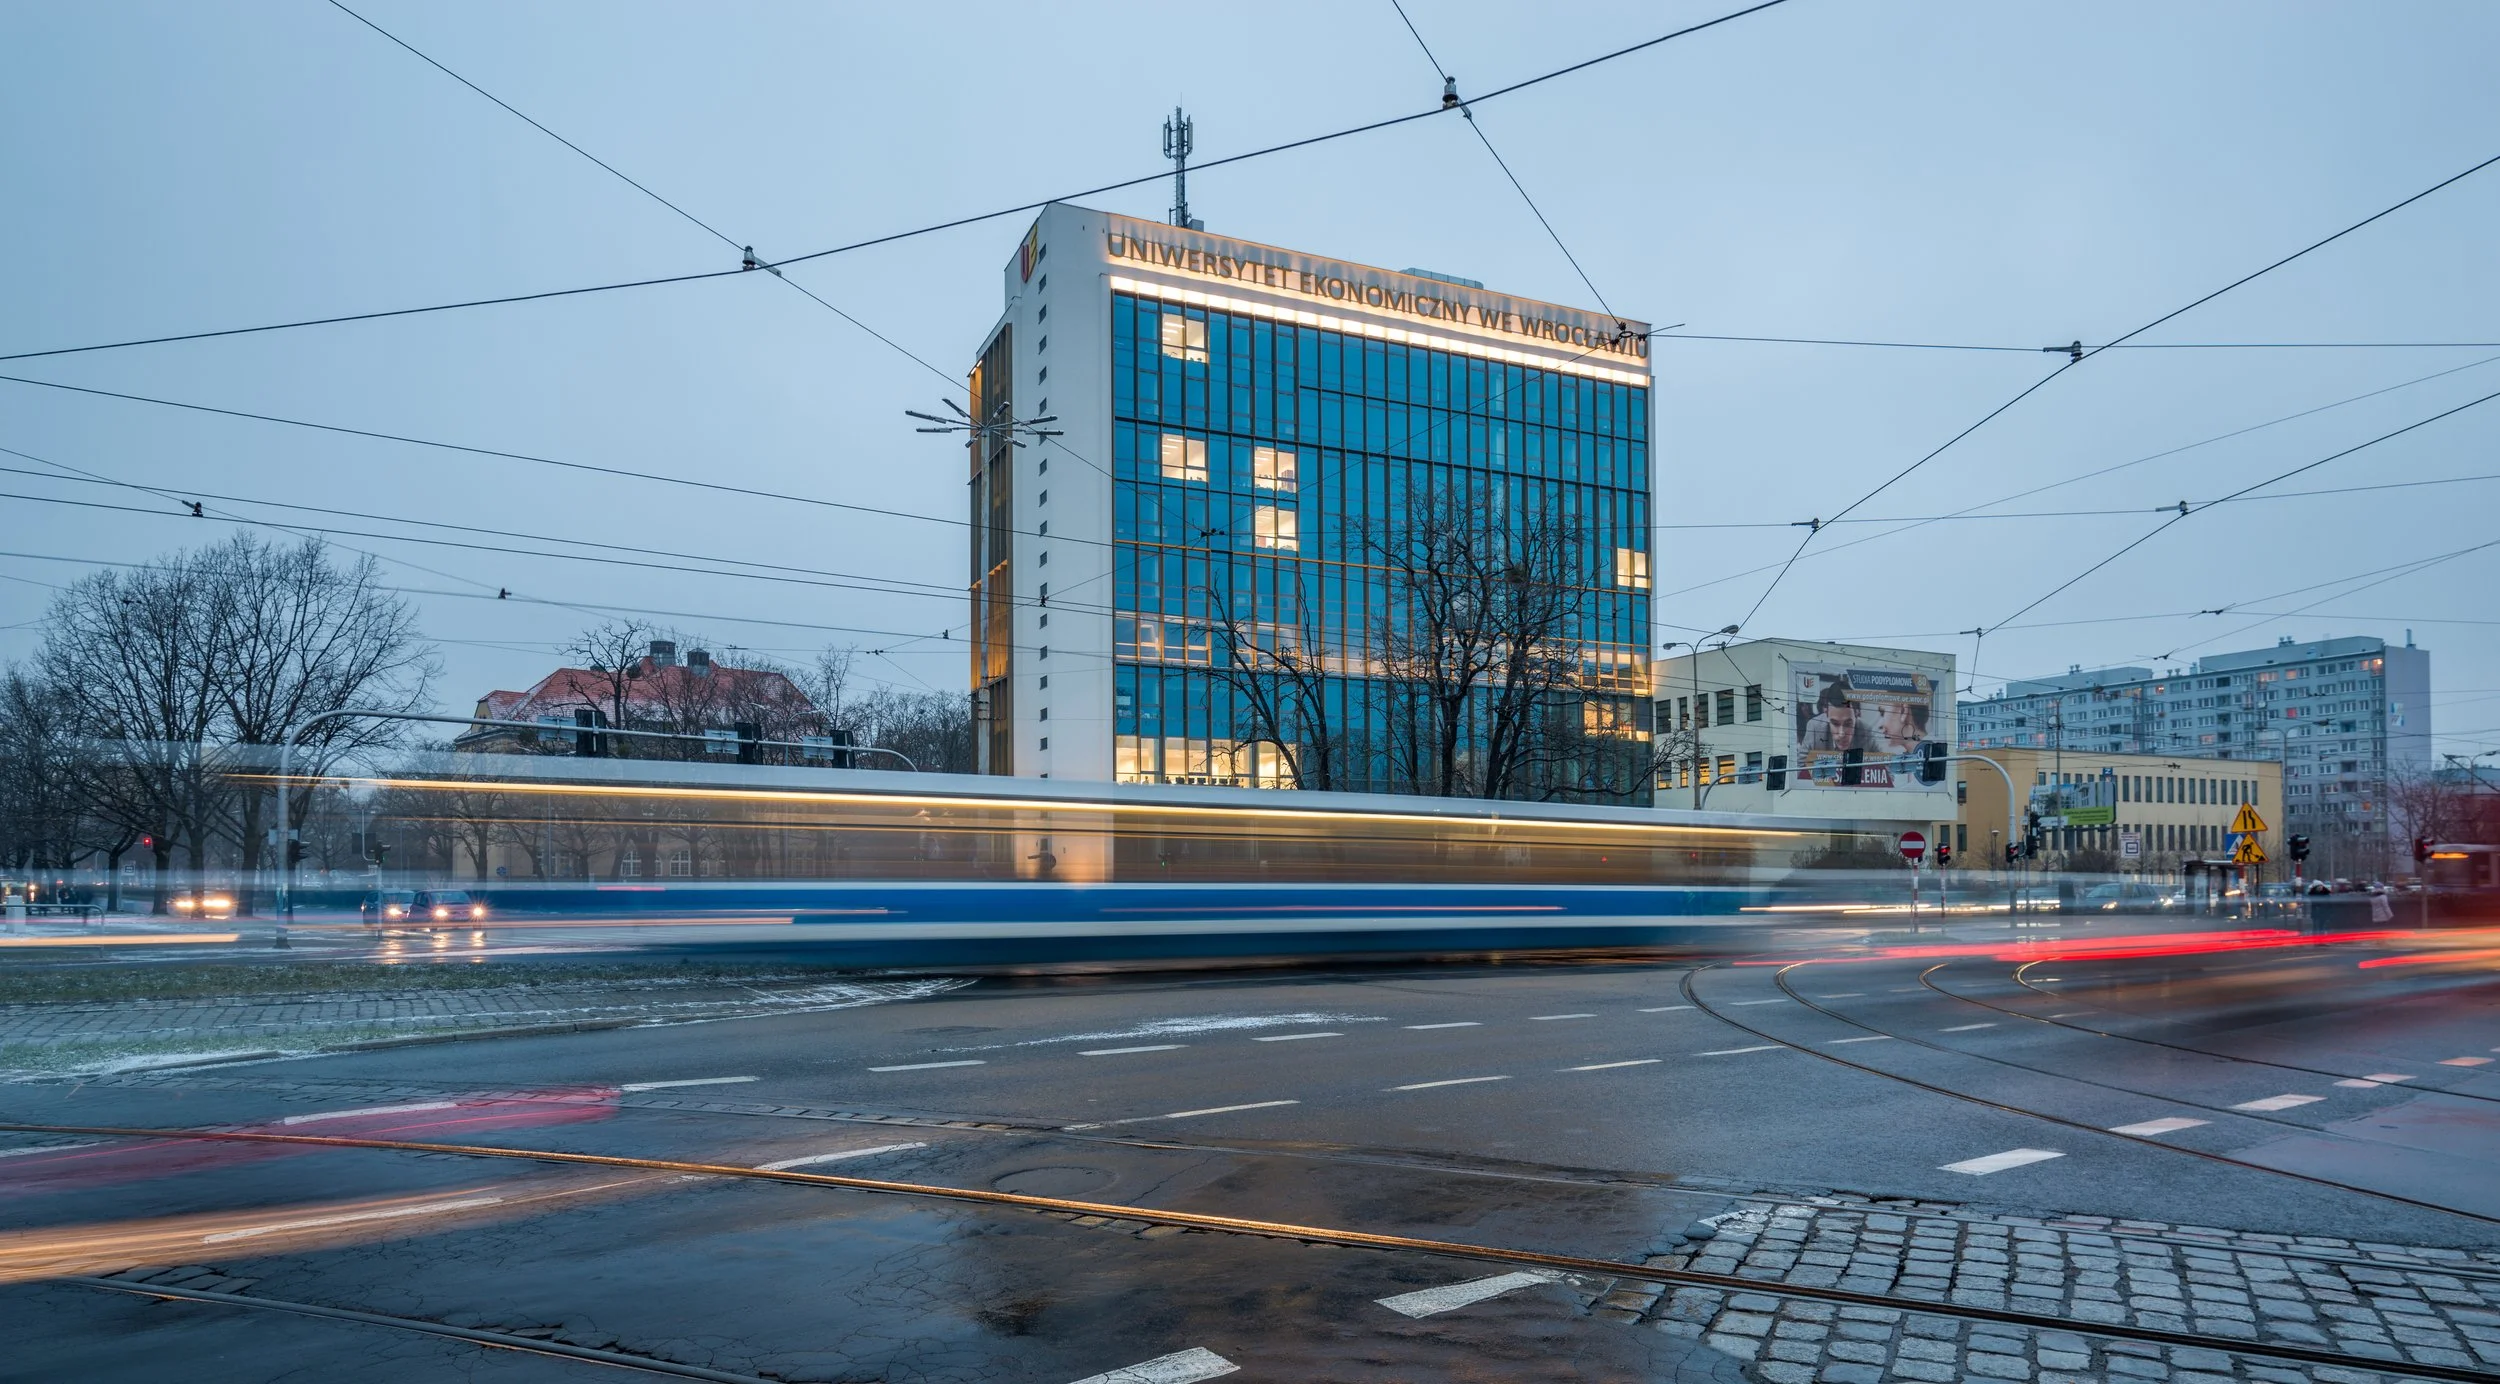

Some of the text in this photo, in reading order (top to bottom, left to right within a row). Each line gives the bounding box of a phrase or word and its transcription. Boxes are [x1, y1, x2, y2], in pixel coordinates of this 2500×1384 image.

[1108, 233, 1649, 359] UNIWERSYTET EKONOMICZNY WE WROCŁAWIU
[1852, 674, 1913, 687] STUDIA PODYPLOMOWE
